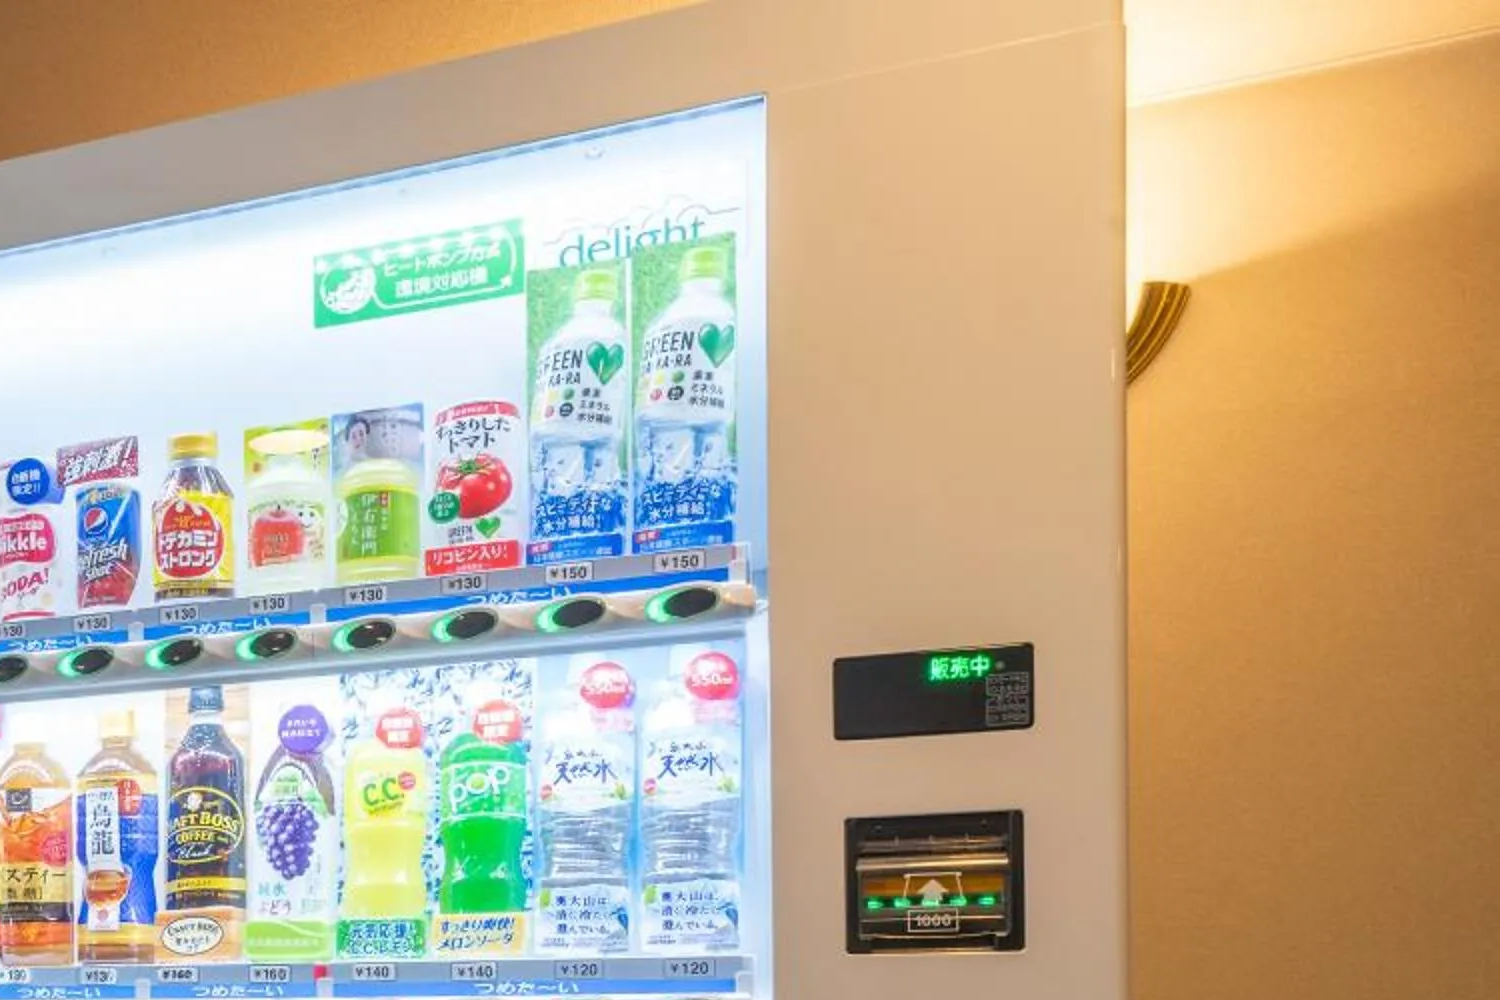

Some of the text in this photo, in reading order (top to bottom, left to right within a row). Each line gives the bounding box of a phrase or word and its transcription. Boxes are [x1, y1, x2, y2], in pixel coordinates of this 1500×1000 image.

[449, 433, 496, 453] トマト
[160, 550, 216, 570] ストロング
[662, 554, 700, 568] ¥150
[550, 565, 587, 579] ¥150
[449, 576, 481, 590] ¥130
[350, 588, 383, 602] ¥130
[253, 597, 286, 611] ¥130
[165, 607, 197, 620] ¥130
[76, 616, 108, 629] ¥130
[929, 655, 990, 681] 販売中
[553, 759, 618, 786] 天然水
[657, 751, 724, 780] 天然水
[915, 913, 951, 927] 1000
[254, 968, 287, 980] ¥160
[355, 965, 390, 978] ¥140
[457, 965, 494, 979] ¥140
[560, 963, 598, 977] ¥120
[670, 961, 710, 976] ¥120
